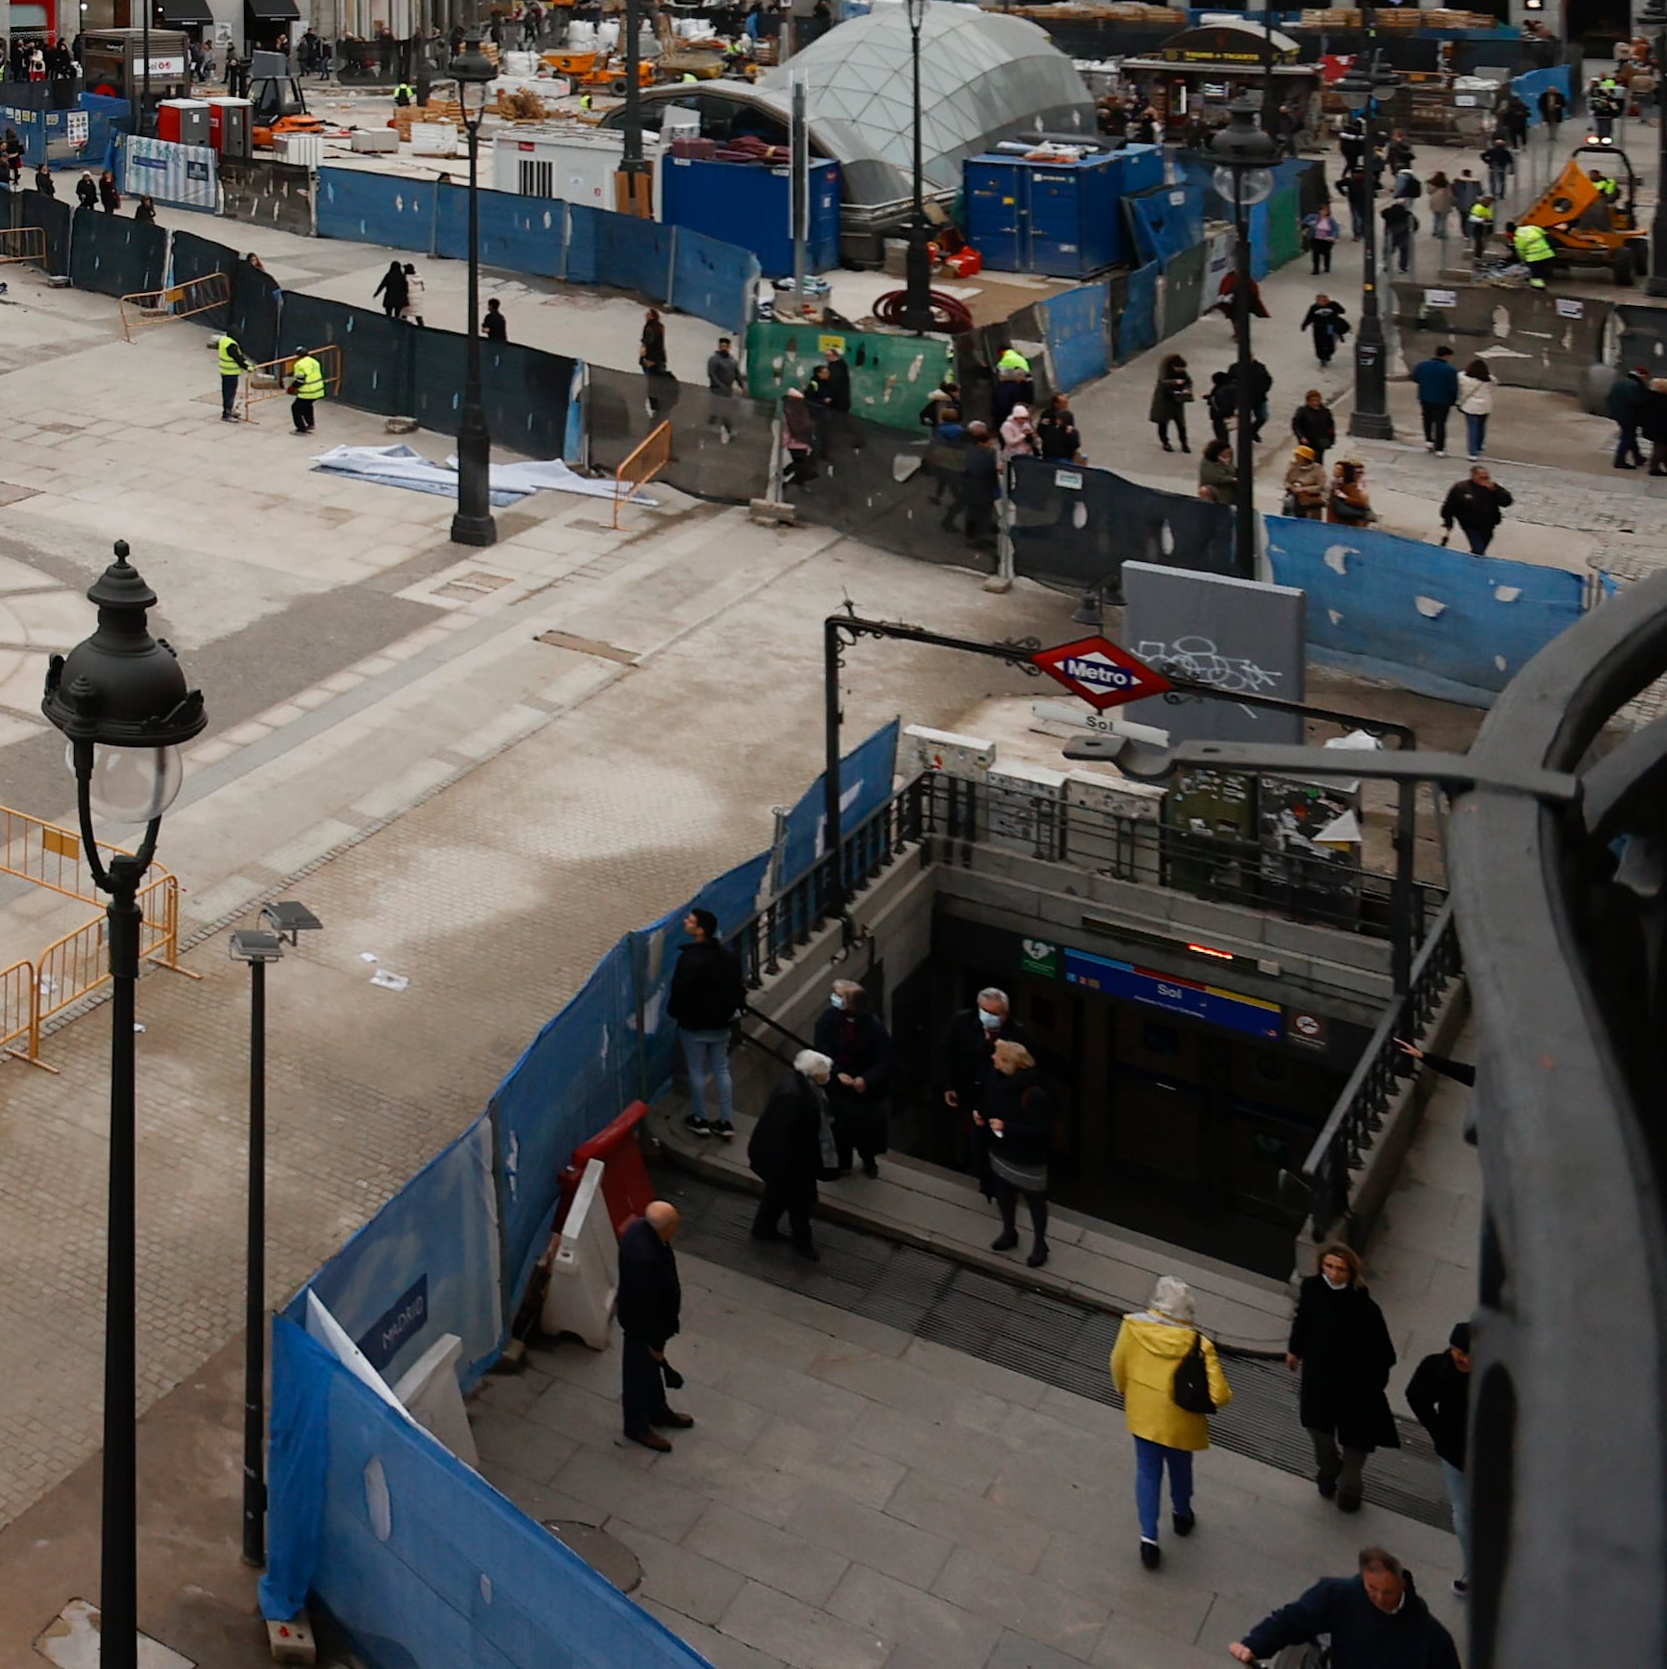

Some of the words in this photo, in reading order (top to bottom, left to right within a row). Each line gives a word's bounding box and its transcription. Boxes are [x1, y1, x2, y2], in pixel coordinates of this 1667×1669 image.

[1067, 659, 1128, 685] Metro
[1086, 715, 1114, 731] Sol
[1157, 983, 1183, 1000] Sol
